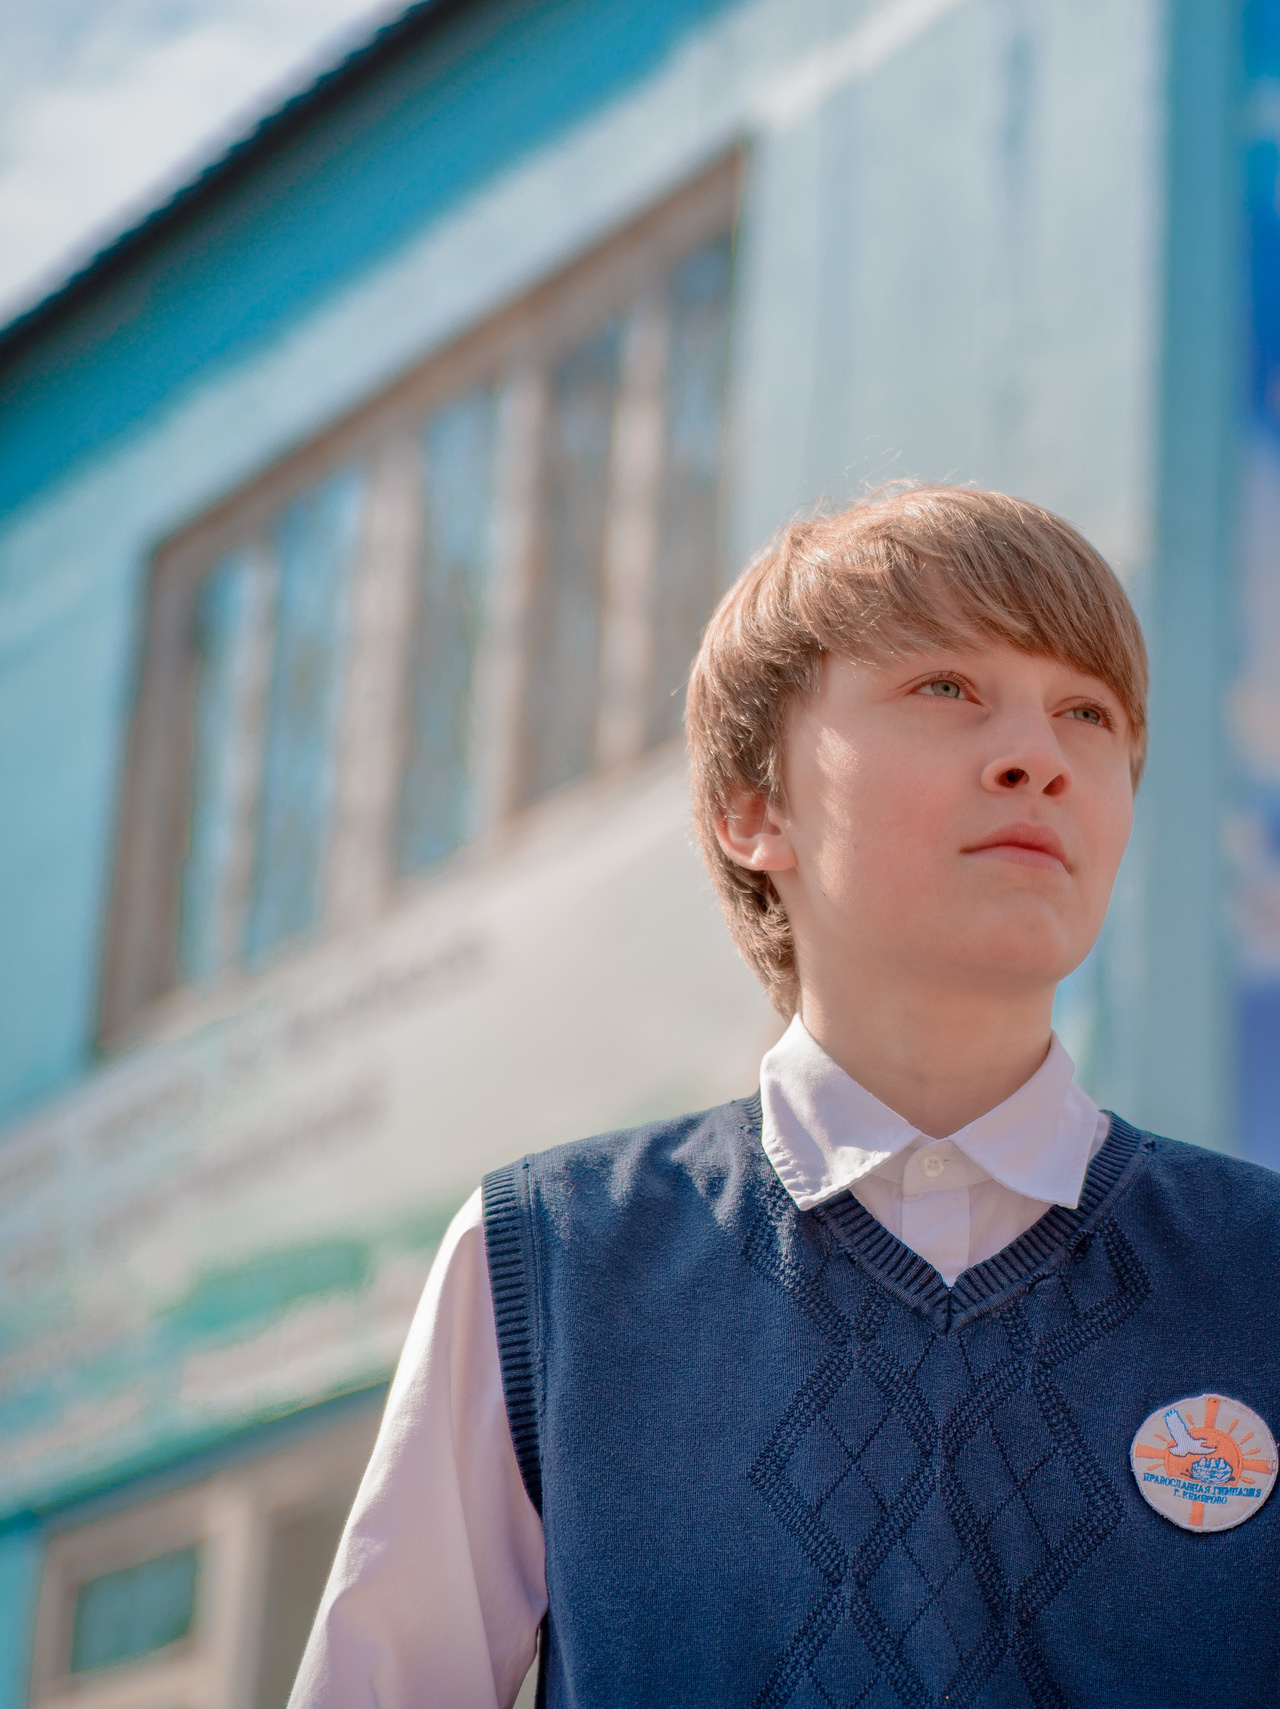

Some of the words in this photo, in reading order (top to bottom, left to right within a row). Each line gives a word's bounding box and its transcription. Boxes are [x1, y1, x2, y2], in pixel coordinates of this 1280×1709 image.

[1143, 1472, 1210, 1494] ПРАВОСЛАВНАЯ
[1211, 1486, 1262, 1498] ГИМНАЗИЯ
[1182, 1490, 1228, 1504] КЕМЕРОВО
